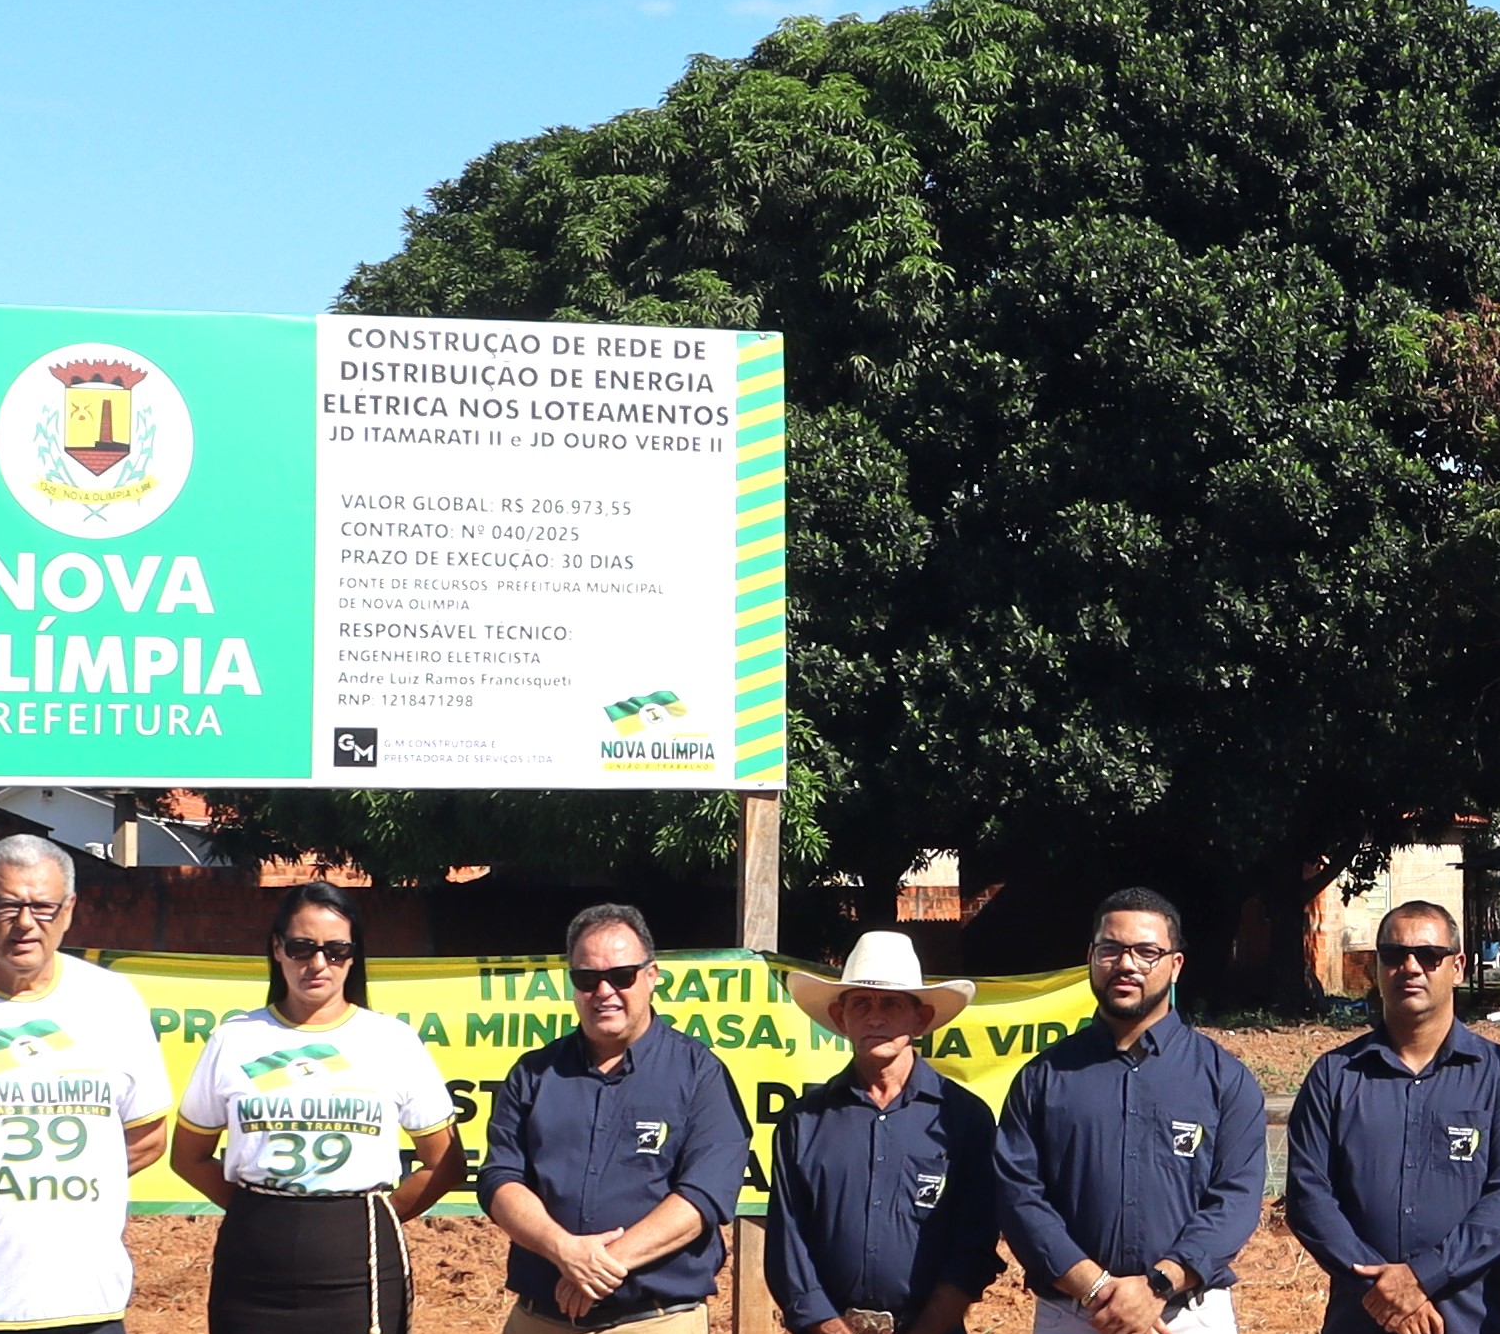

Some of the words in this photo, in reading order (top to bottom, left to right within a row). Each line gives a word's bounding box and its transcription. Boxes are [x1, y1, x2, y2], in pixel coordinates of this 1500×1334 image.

[347, 327, 541, 359] CONSTRUÇÃO
[552, 335, 585, 356] DE
[598, 336, 662, 358] REDE
[674, 340, 706, 360] DE
[340, 359, 539, 392] DISTRIBUIÇÃO
[550, 368, 583, 388] DE
[595, 369, 714, 393] ENERGIA
[323, 388, 448, 418] ELÉTRICA
[459, 398, 519, 420] NOS
[530, 400, 729, 427] LOTEAMENTOS
[328, 426, 354, 442] JD
[364, 426, 479, 446] ITAMARATI
[489, 430, 502, 446] II
[510, 434, 522, 447] e
[530, 431, 555, 448] JD
[564, 432, 628, 451] OURO
[635, 435, 701, 453] VERDE
[710, 437, 722, 453] II
[341, 494, 406, 511] VALOR
[413, 496, 494, 513] GLOBAL:
[501, 497, 524, 514] R$
[531, 498, 632, 517] 206.973,55
[341, 522, 455, 539] CONTRATO:
[491, 524, 580, 542] 040/2025
[341, 549, 408, 566] PRAZO
[416, 550, 439, 566] DE
[446, 549, 554, 571] EXECUÇÃO:
[561, 553, 583, 569] 30
[590, 554, 634, 570] DIAS
[339, 577, 385, 590] FONTE
[391, 578, 408, 590] DE
[497, 580, 581, 593] PREFEITURA
[586, 582, 665, 595] MUNICIPAL
[338, 597, 356, 609] DE
[362, 598, 404, 610] NOVA
[339, 620, 477, 639] RESPONSÁVEL
[484, 621, 573, 641] TÉCNICO:
[338, 650, 442, 663] ENGENHEIRO
[447, 650, 541, 664] ELETRICISTA
[338, 672, 384, 684] Andre
[390, 672, 419, 685] Luiz
[425, 673, 475, 686] Ramos
[481, 673, 572, 689] Francisqueti
[338, 694, 375, 706] RNP:
[381, 694, 474, 707] 1218471298
[408, 740, 487, 749] CONSTRUTORA
[601, 740, 646, 759] NOVA
[651, 738, 715, 760] OLÍMPIA
[384, 754, 454, 763] PRESTADORA
[457, 754, 470, 763] DE
[527, 755, 553, 764] LTDA
[479, 967, 751, 1003] ITARATI
[31, 1075, 111, 1105] OLÍMPIA
[39, 1105, 107, 1115] TRABALHO
[237, 1096, 294, 1122] NOVA
[2, 1116, 88, 1162] 39
[291, 1122, 299, 1130] E
[306, 1122, 377, 1135] TRABALHO
[267, 1132, 352, 1178] 39
